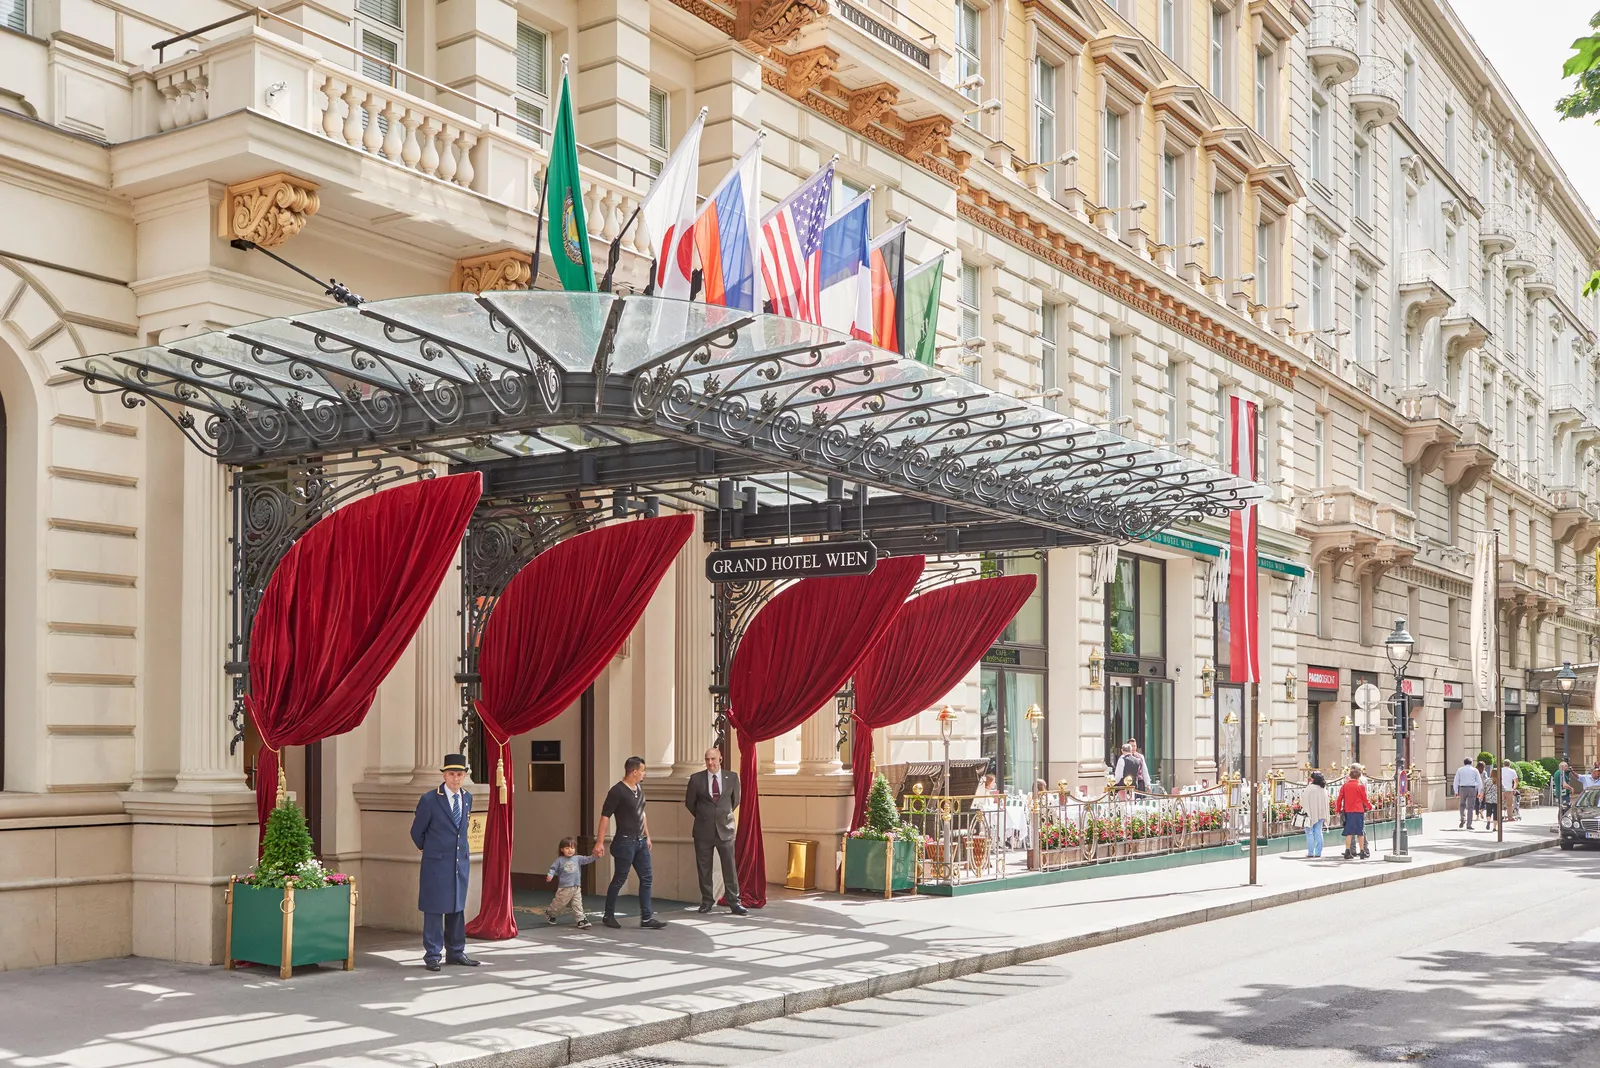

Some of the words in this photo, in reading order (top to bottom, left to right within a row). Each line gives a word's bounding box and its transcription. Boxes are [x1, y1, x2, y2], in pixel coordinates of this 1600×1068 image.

[1163, 535, 1180, 546] HOTEL
[712, 557, 767, 574] GRAND
[771, 554, 821, 571] HOTEL
[825, 550, 869, 567] WIEN
